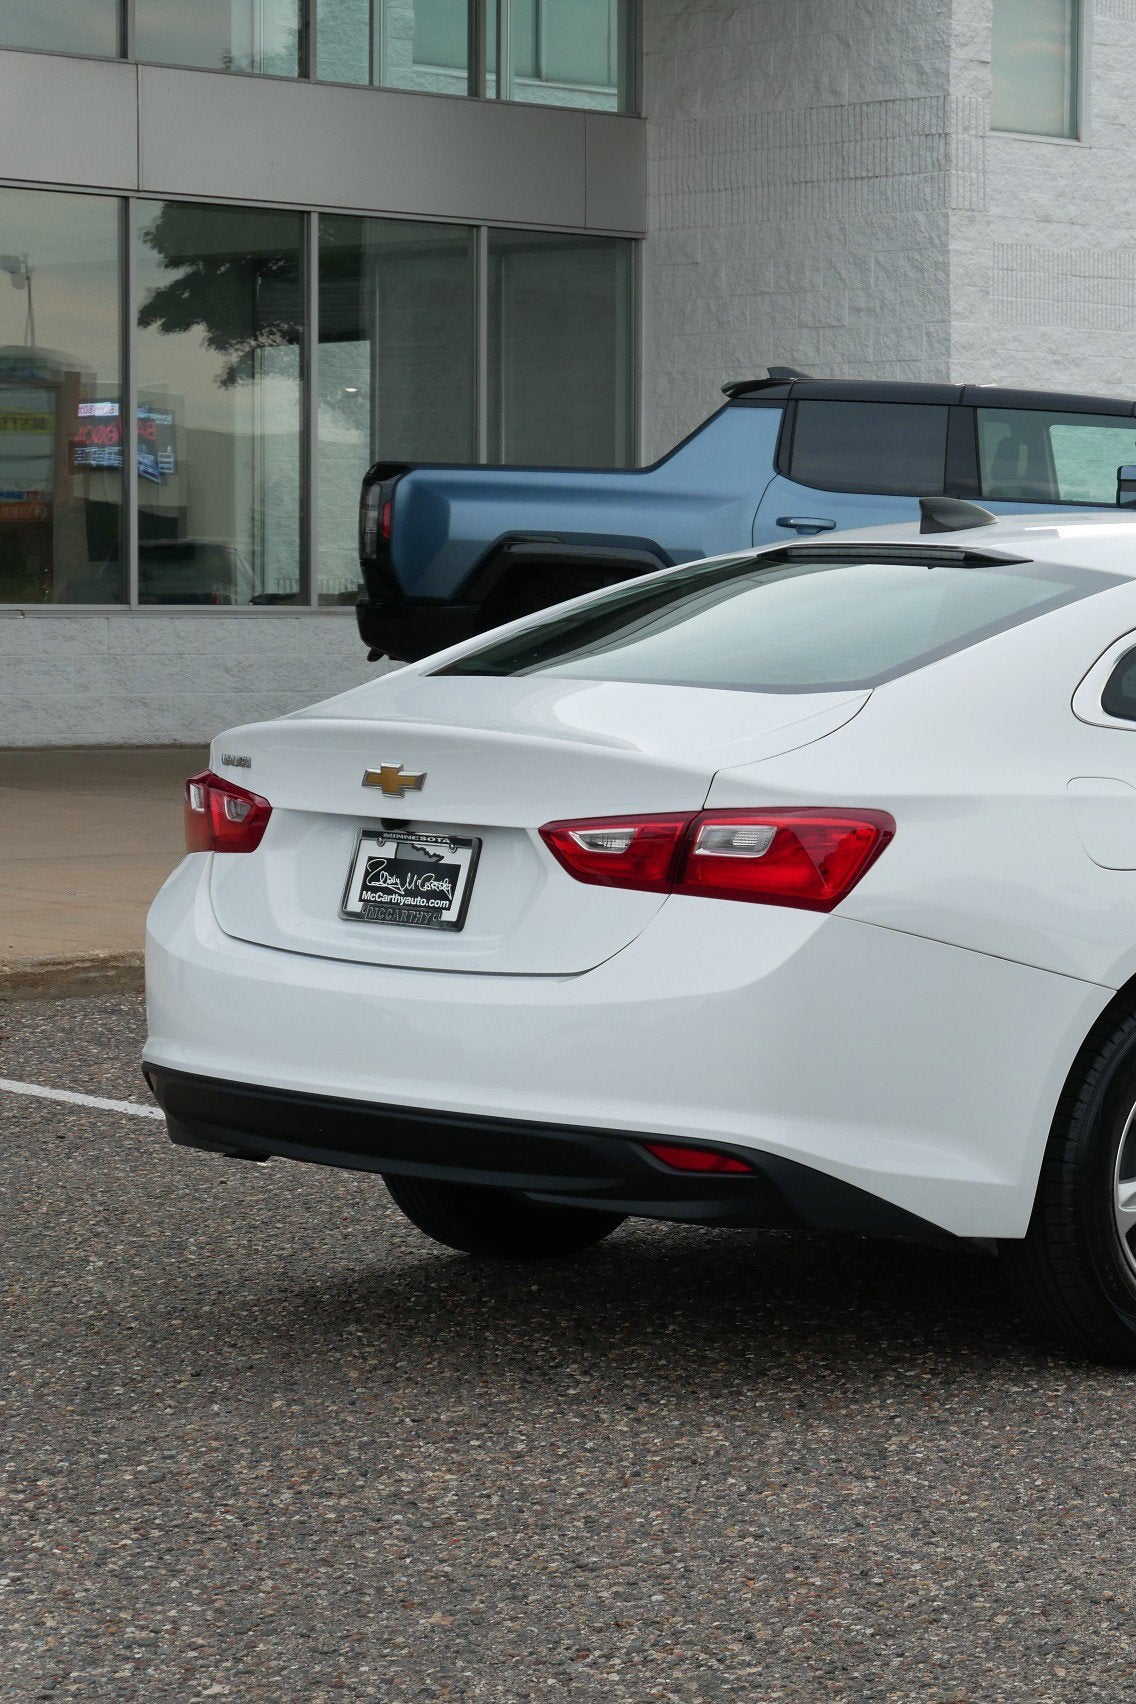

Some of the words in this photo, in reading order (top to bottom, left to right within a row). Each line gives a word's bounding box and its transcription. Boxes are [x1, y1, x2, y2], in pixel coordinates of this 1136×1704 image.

[383, 832, 452, 844] MINNESOTA
[361, 890, 450, 909] McCarthyauto.com
[367, 906, 432, 924] MCCARTHY
